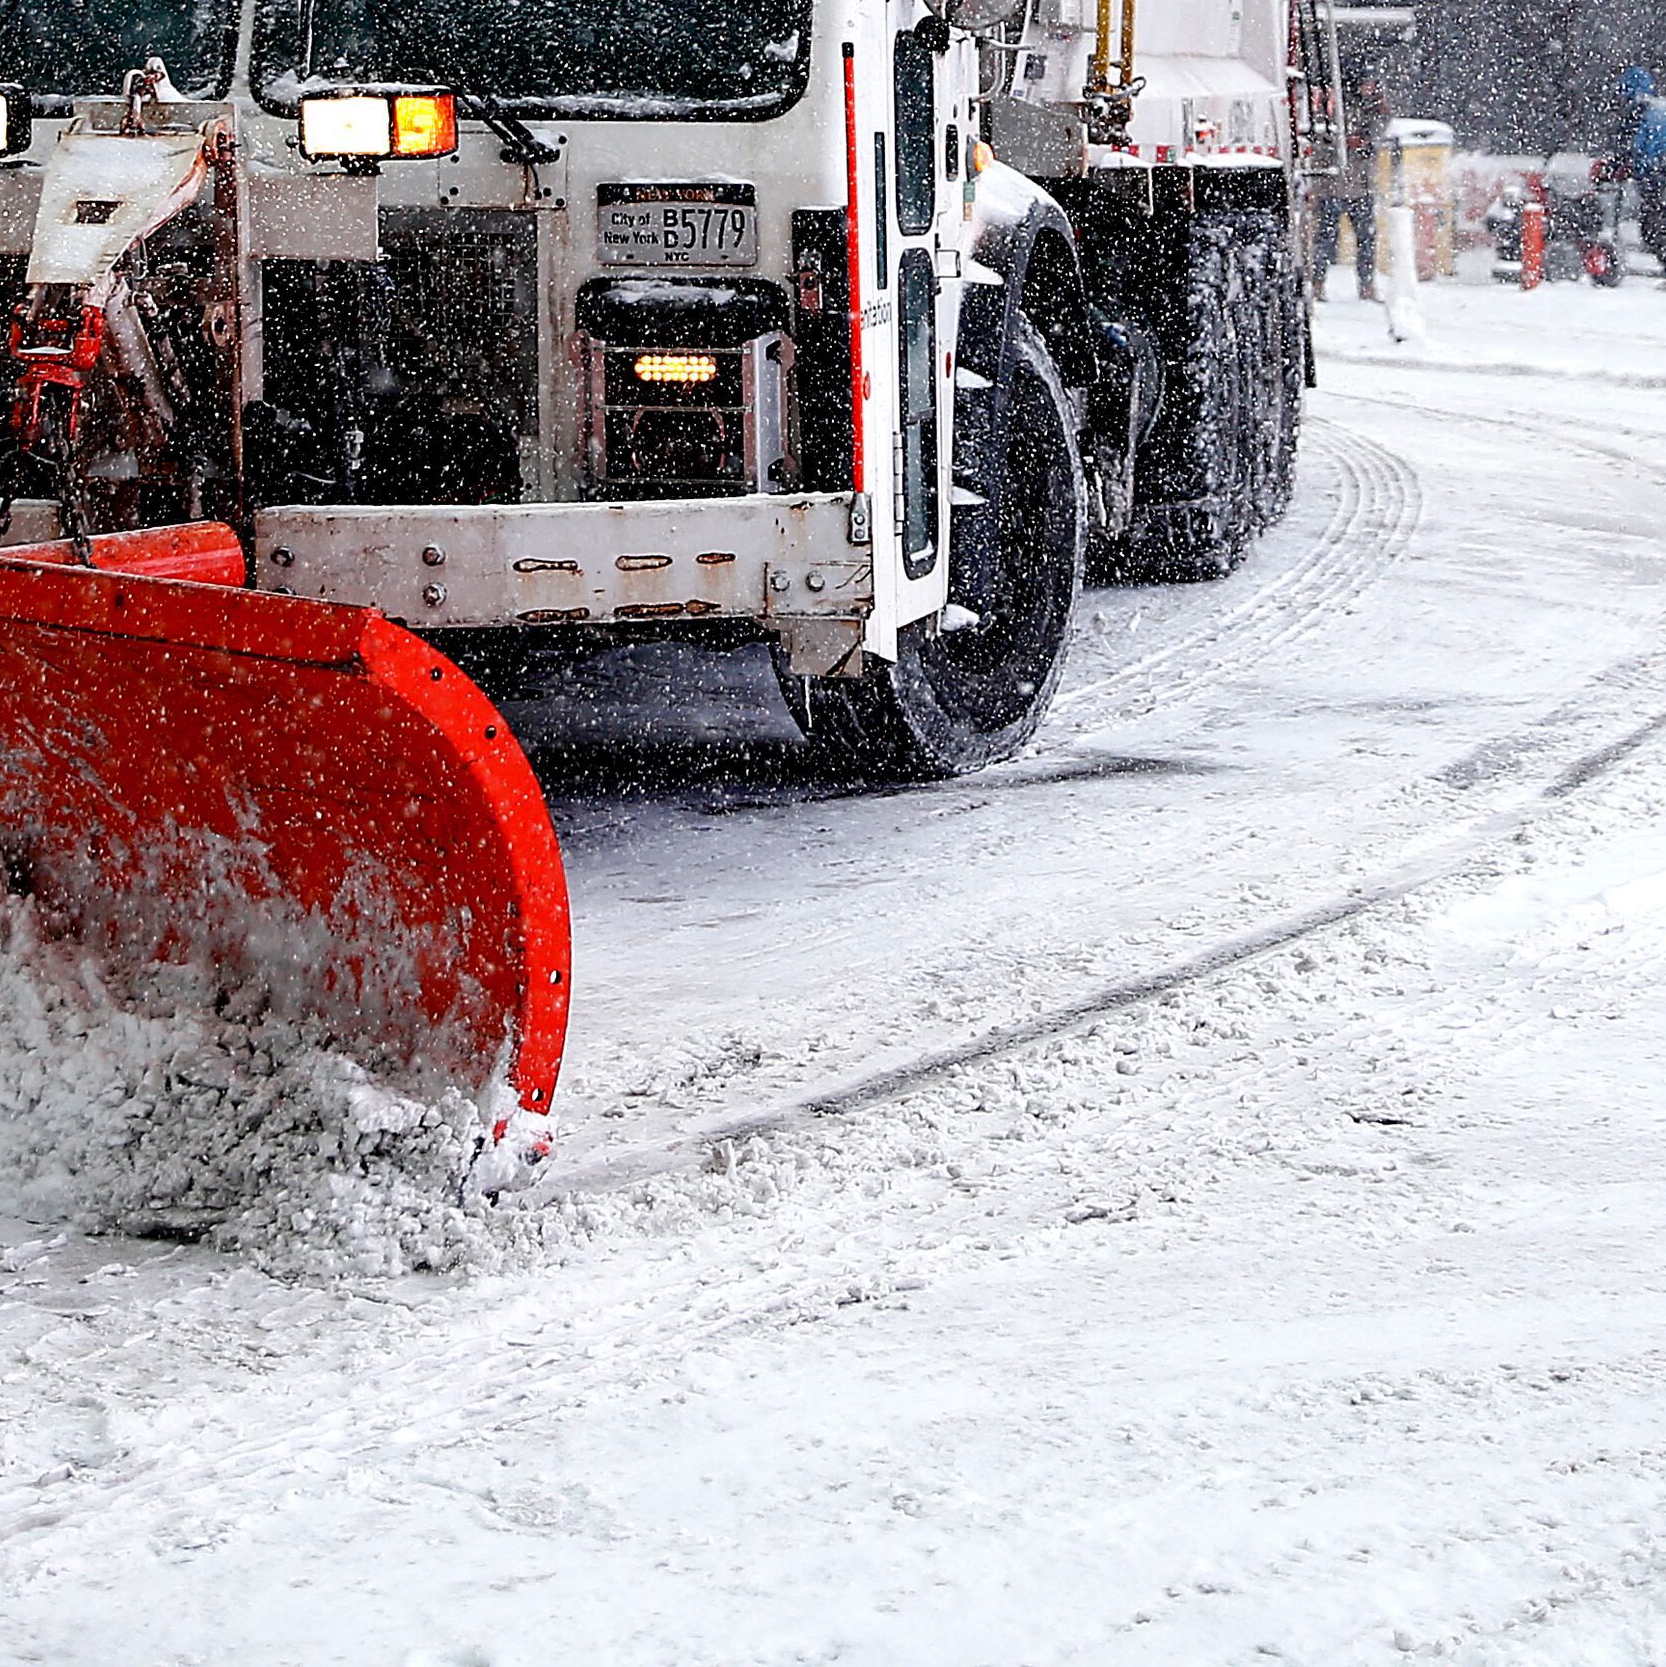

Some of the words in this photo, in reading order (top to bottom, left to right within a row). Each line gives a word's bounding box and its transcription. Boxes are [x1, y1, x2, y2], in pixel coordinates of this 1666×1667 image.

[636, 188, 670, 201] NEW
[676, 188, 716, 202] YORK
[611, 212, 634, 227] City
[638, 212, 651, 226] of
[604, 231, 630, 244] New
[632, 231, 660, 245] York
[664, 252, 690, 262] NYC
